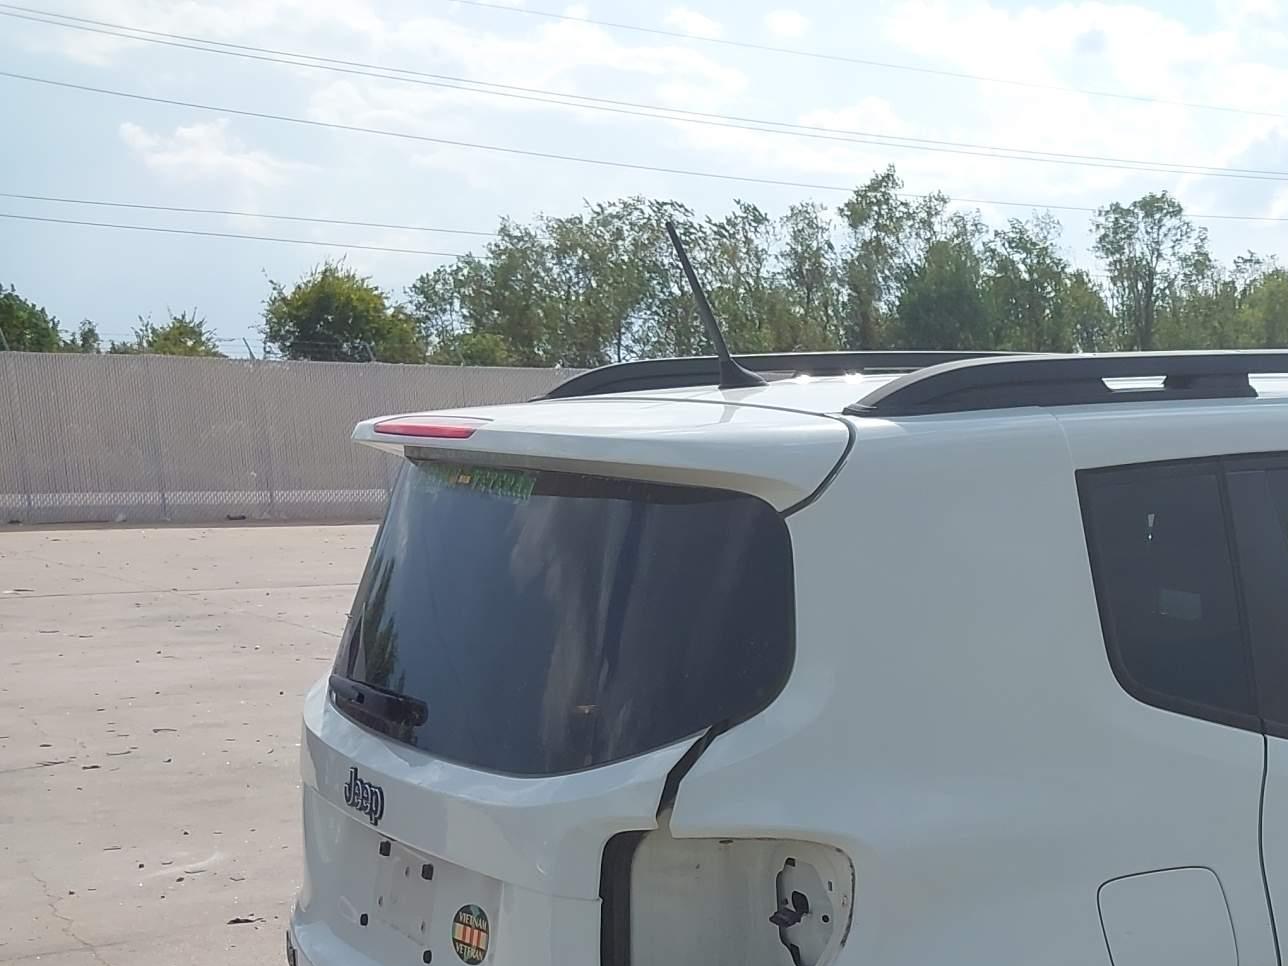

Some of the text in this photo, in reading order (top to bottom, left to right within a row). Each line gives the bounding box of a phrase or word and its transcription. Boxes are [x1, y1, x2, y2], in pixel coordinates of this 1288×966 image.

[343, 767, 385, 826] Jeep
[458, 911, 488, 931] VIETNAM
[455, 942, 484, 961] VETERAN
